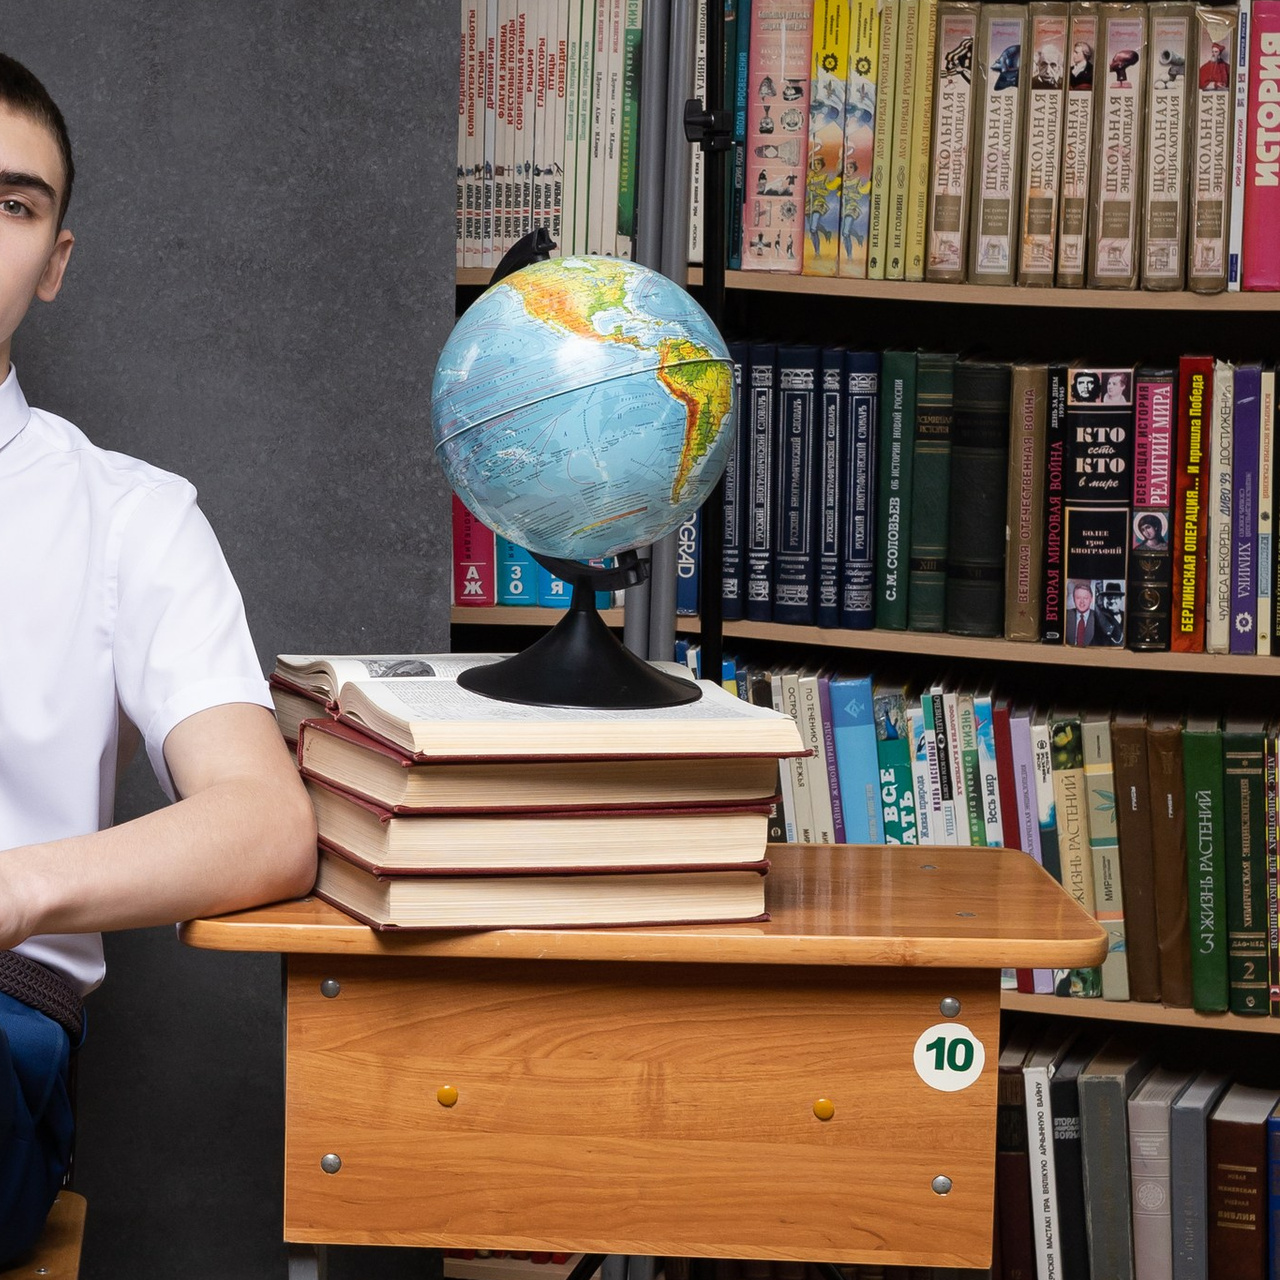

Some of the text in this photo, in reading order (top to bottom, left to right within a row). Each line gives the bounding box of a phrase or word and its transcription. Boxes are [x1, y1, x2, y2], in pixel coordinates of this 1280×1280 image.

[468, 10, 476, 51] РОБОТЫ
[499, 24, 508, 71] ЗНАМЕНА
[477, 51, 485, 98] ПУСТЫНИ
[485, 37, 495, 109] ДРЕВНИЙ РИМ
[507, 20, 517, 125] КРЕСТОВЫЕ ПОХОДЫ
[515, 13, 526, 130] СОВРЕМЕННАЯ ФИЗИКА
[526, 49, 535, 92] РЫЦАРИ
[536, 38, 546, 107] ГЛАДИАТОРЫ
[547, 54, 557, 90] ПТИЦЫ
[557, 40, 566, 98] СОЗВЕЗДИЯ
[467, 64, 475, 137] КОМПЬЮТЕРЫ
[497, 84, 506, 119] ФЛАГИ
[735, 52, 747, 135] ЭПОХА ПРОСВЕЩЕНИЯ
[1255, 33, 1280, 187] ИСТОРИЯ
[938, 92, 954, 187] ШКОЛЬНАЯ
[951, 92, 966, 188] ЭНЦИКЛОПЕДИЯ
[985, 94, 1002, 190] ШКОЛЬНАЯ
[484, 184, 492, 209] ПОЧЕМУ
[483, 217, 492, 239] ЗАЧЕМ
[1051, 376, 1060, 428] ДЕНЬ ЗА ДНЕМ
[1190, 375, 1204, 416] Победа
[1076, 428, 1126, 443] КТО
[1088, 446, 1115, 454] есть
[1136, 386, 1149, 503] ВСЕОБЩАЯ ИСТОРИЯ
[1148, 386, 1170, 504] РЕЛИГИЙ МИРА
[1189, 419, 1201, 463] пришла
[755, 395, 767, 541] РУССКИЙ БИОГРАФИЧЕСКИЙ СЛОВАРЬ
[886, 379, 904, 600] С. М. СОЛОВЬЕВ ОБ ИСТОРИИ НОВОЙ РОССИИ
[1076, 458, 1126, 473] КТО
[1078, 478, 1119, 490] в мире
[1019, 389, 1035, 602] ВЕЛИКАЯ ОТЕЧЕСТВЕННАЯ ВОЙНА
[1047, 441, 1063, 620] ВТОРАЯ МИРОВАЯ ВОЙНА
[1071, 547, 1122, 555] БИОГРАФИЙ
[464, 581, 483, 594] Ж
[1181, 555, 1196, 632] БЕРЛИНСКАЯ
[1219, 523, 1230, 620] ЧУДЕСА РЕКОРДЫ
[1238, 542, 1250, 598] ХИМИКА
[805, 688, 813, 701] ПО
[806, 704, 817, 742] ТЕЧЕНИЮ
[962, 710, 973, 748] ЖИЗНЬ
[825, 721, 843, 829] ТАЙНЫ ЖИВОЙ ПРИРОДЫ
[986, 774, 998, 823] Весь мир
[917, 775, 930, 838] Живая природа
[1062, 776, 1082, 851] РАСТЕНИЙ
[1195, 790, 1213, 870] РАСТЕНИЙ
[1267, 756, 1279, 949] АТЛАС ЖИВОТНЫХ ДЛЯ ШКОЛЬНИКОВ
[1103, 881, 1114, 901] МИР
[1200, 876, 1213, 930] ЖИЗНЬ
[1244, 962, 1254, 979] 2
[925, 1037, 974, 1071] 10
[1034, 1082, 1044, 1107] ВАЙНУ
[1036, 1111, 1047, 1155] АЙЧЫННУЮ
[1039, 1160, 1050, 1194] ВЯЛІКУЮ
[1042, 1198, 1052, 1212] ПРА
[1218, 1212, 1256, 1221] БИБЛИЯ
[1043, 1217, 1054, 1248] МАСТАКІ
